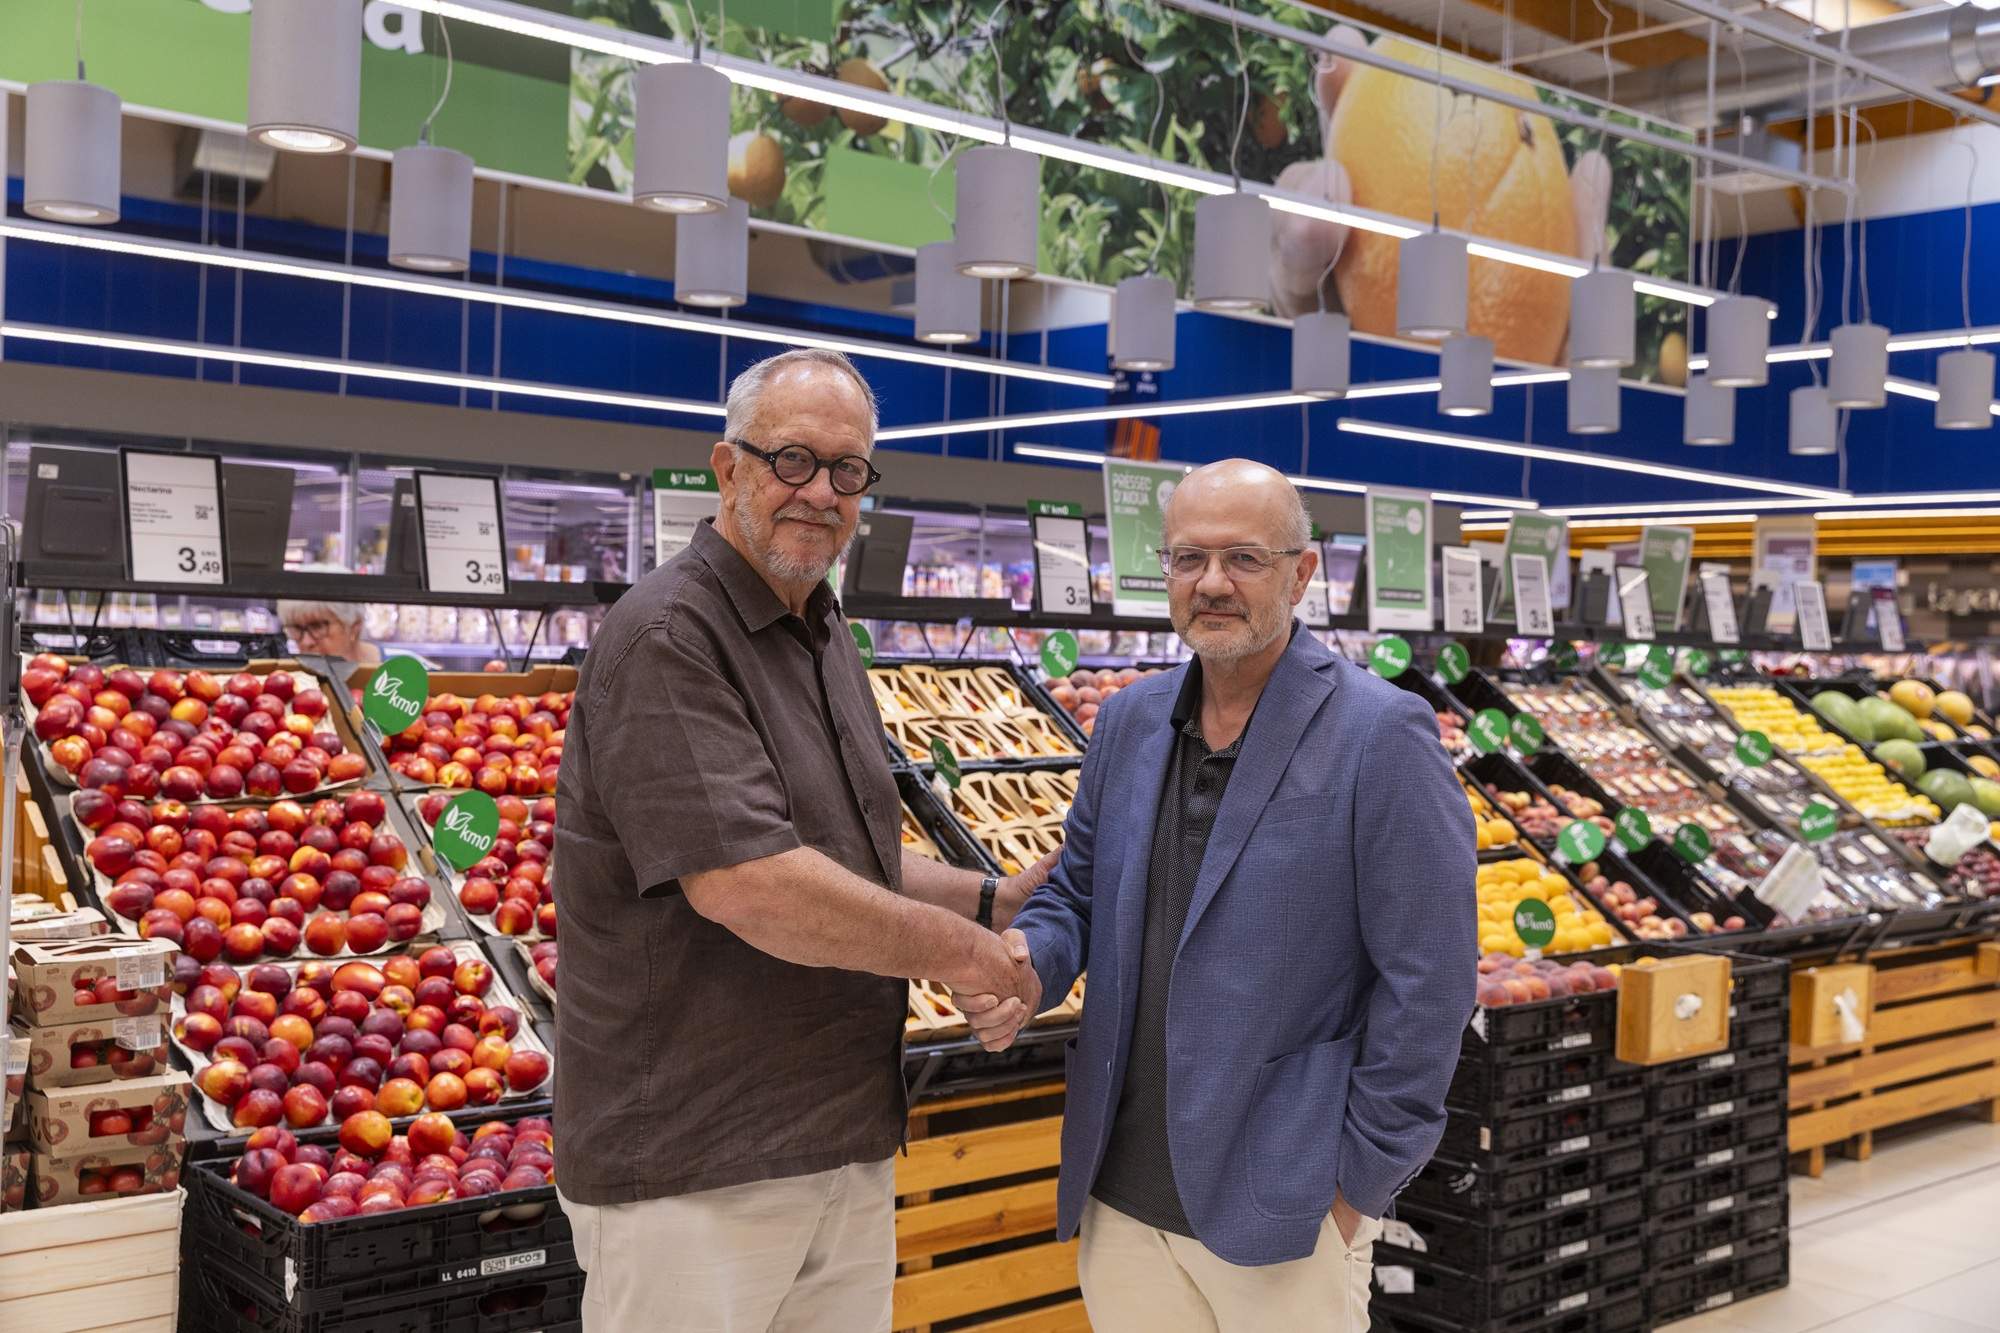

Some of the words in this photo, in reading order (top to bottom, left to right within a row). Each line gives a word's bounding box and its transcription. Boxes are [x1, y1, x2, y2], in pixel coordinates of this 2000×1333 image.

[388, 687, 420, 717] km0
[459, 819, 491, 851] km0
[1532, 918, 1554, 931] km0
[509, 1253, 532, 1266] IFCO
[441, 1272, 453, 1282] LL
[456, 1267, 477, 1279] 6410
